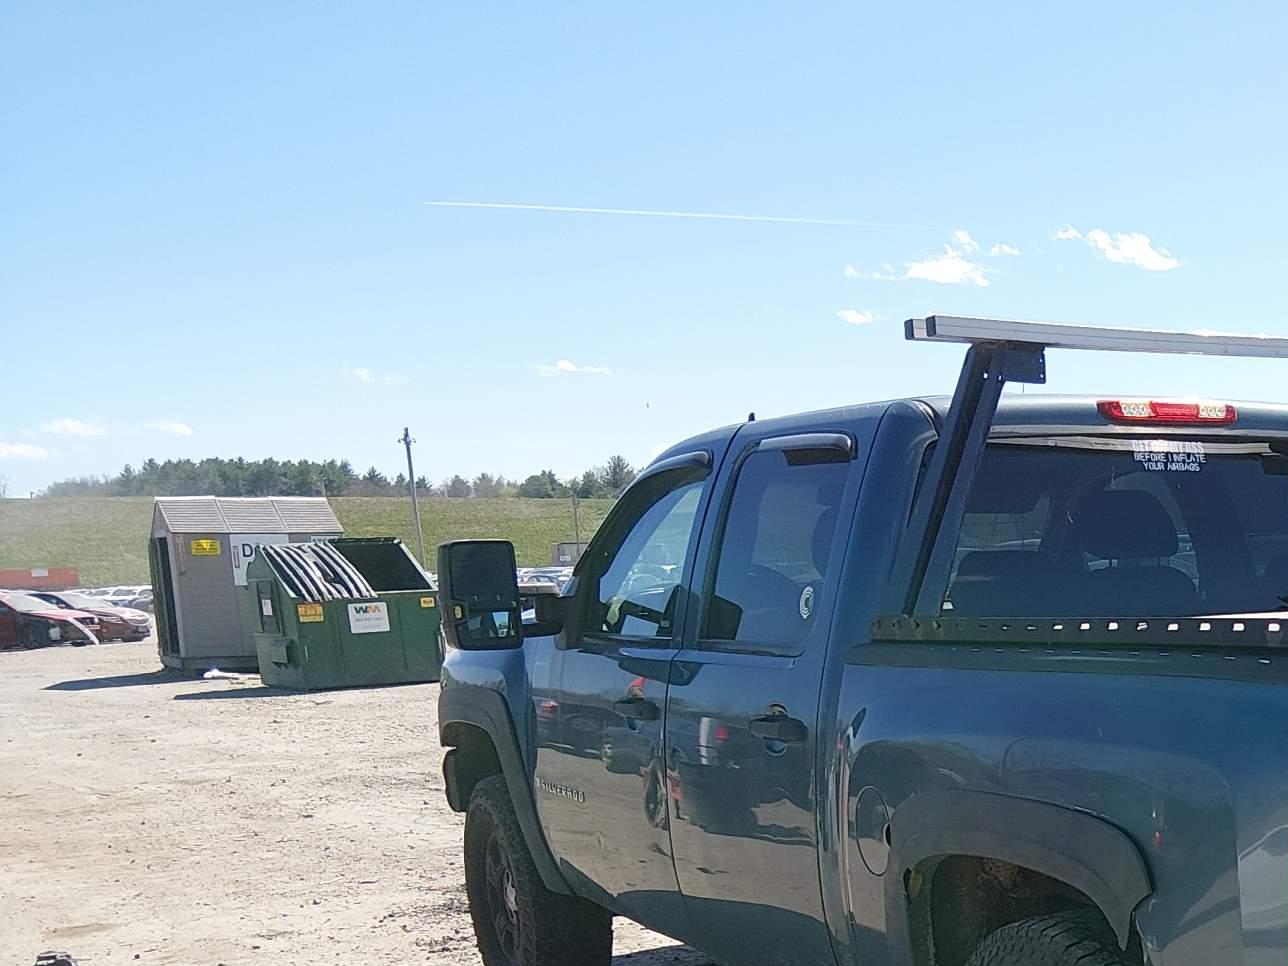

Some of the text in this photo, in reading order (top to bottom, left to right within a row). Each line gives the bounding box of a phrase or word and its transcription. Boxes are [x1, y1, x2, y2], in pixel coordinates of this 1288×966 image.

[1133, 452, 1167, 462] BEFORE
[1172, 453, 1207, 464] INFLATE
[1142, 461, 1201, 472] YOUR AIRBAGS
[353, 604, 382, 615] WM
[540, 778, 586, 804] SILVERADO
